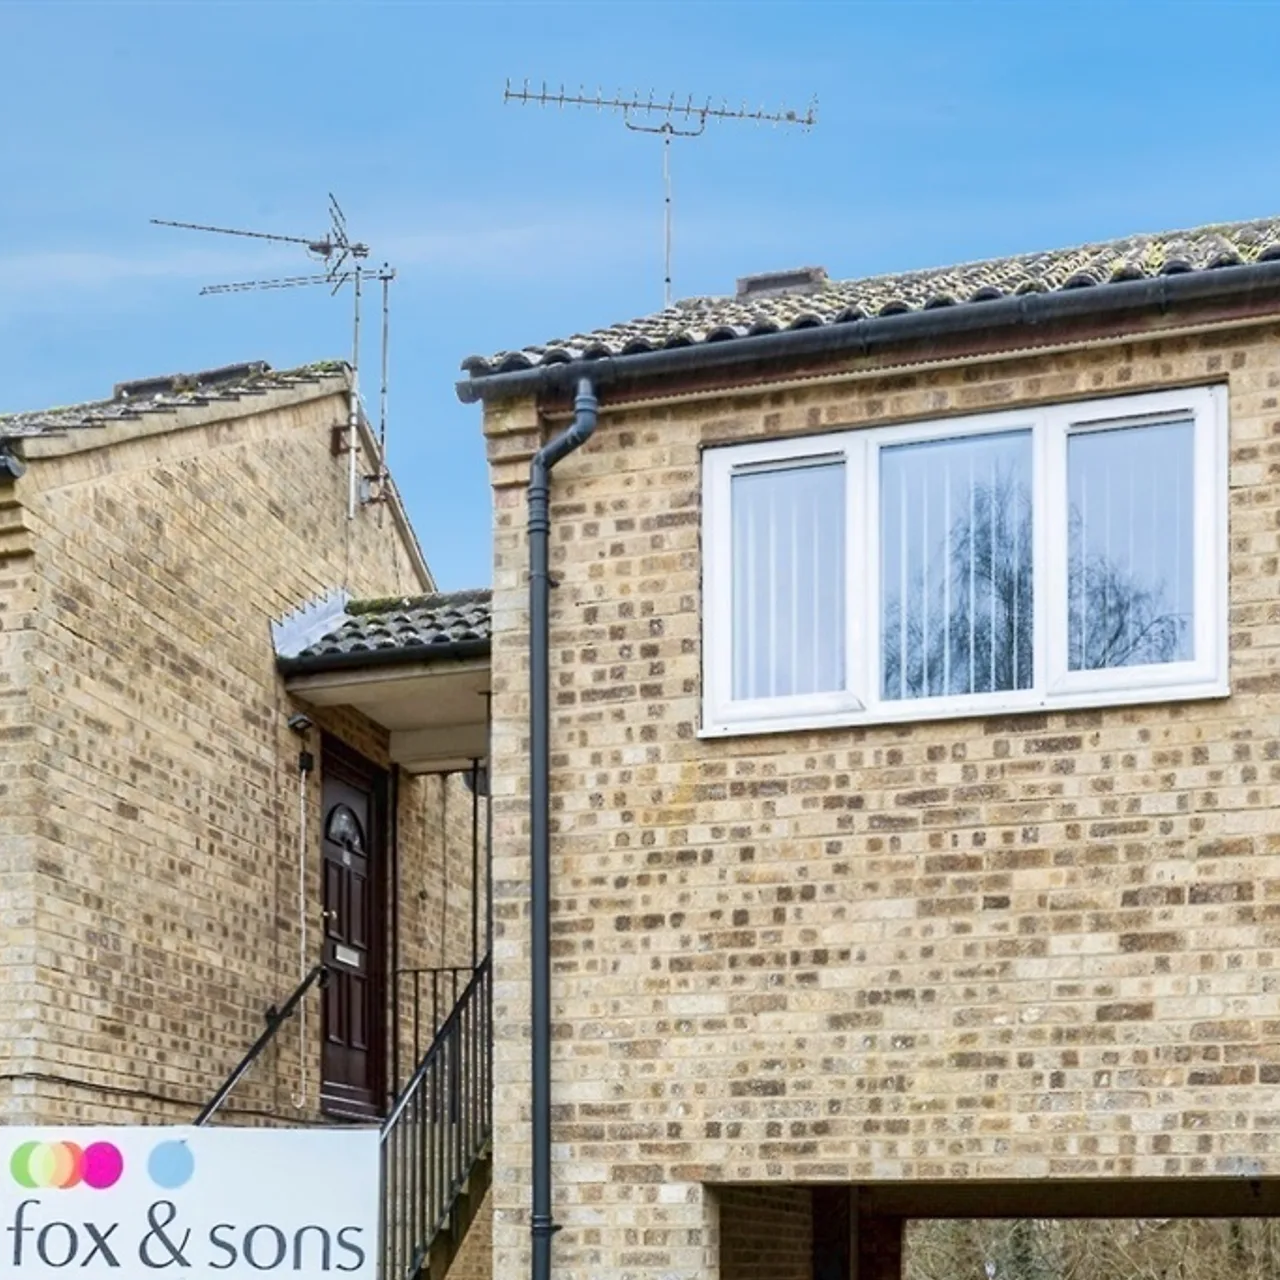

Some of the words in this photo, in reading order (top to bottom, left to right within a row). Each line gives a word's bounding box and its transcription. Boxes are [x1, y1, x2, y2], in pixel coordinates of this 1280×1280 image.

[6, 1199, 121, 1268] fox
[138, 1200, 193, 1269] &
[207, 1223, 366, 1272] sons
